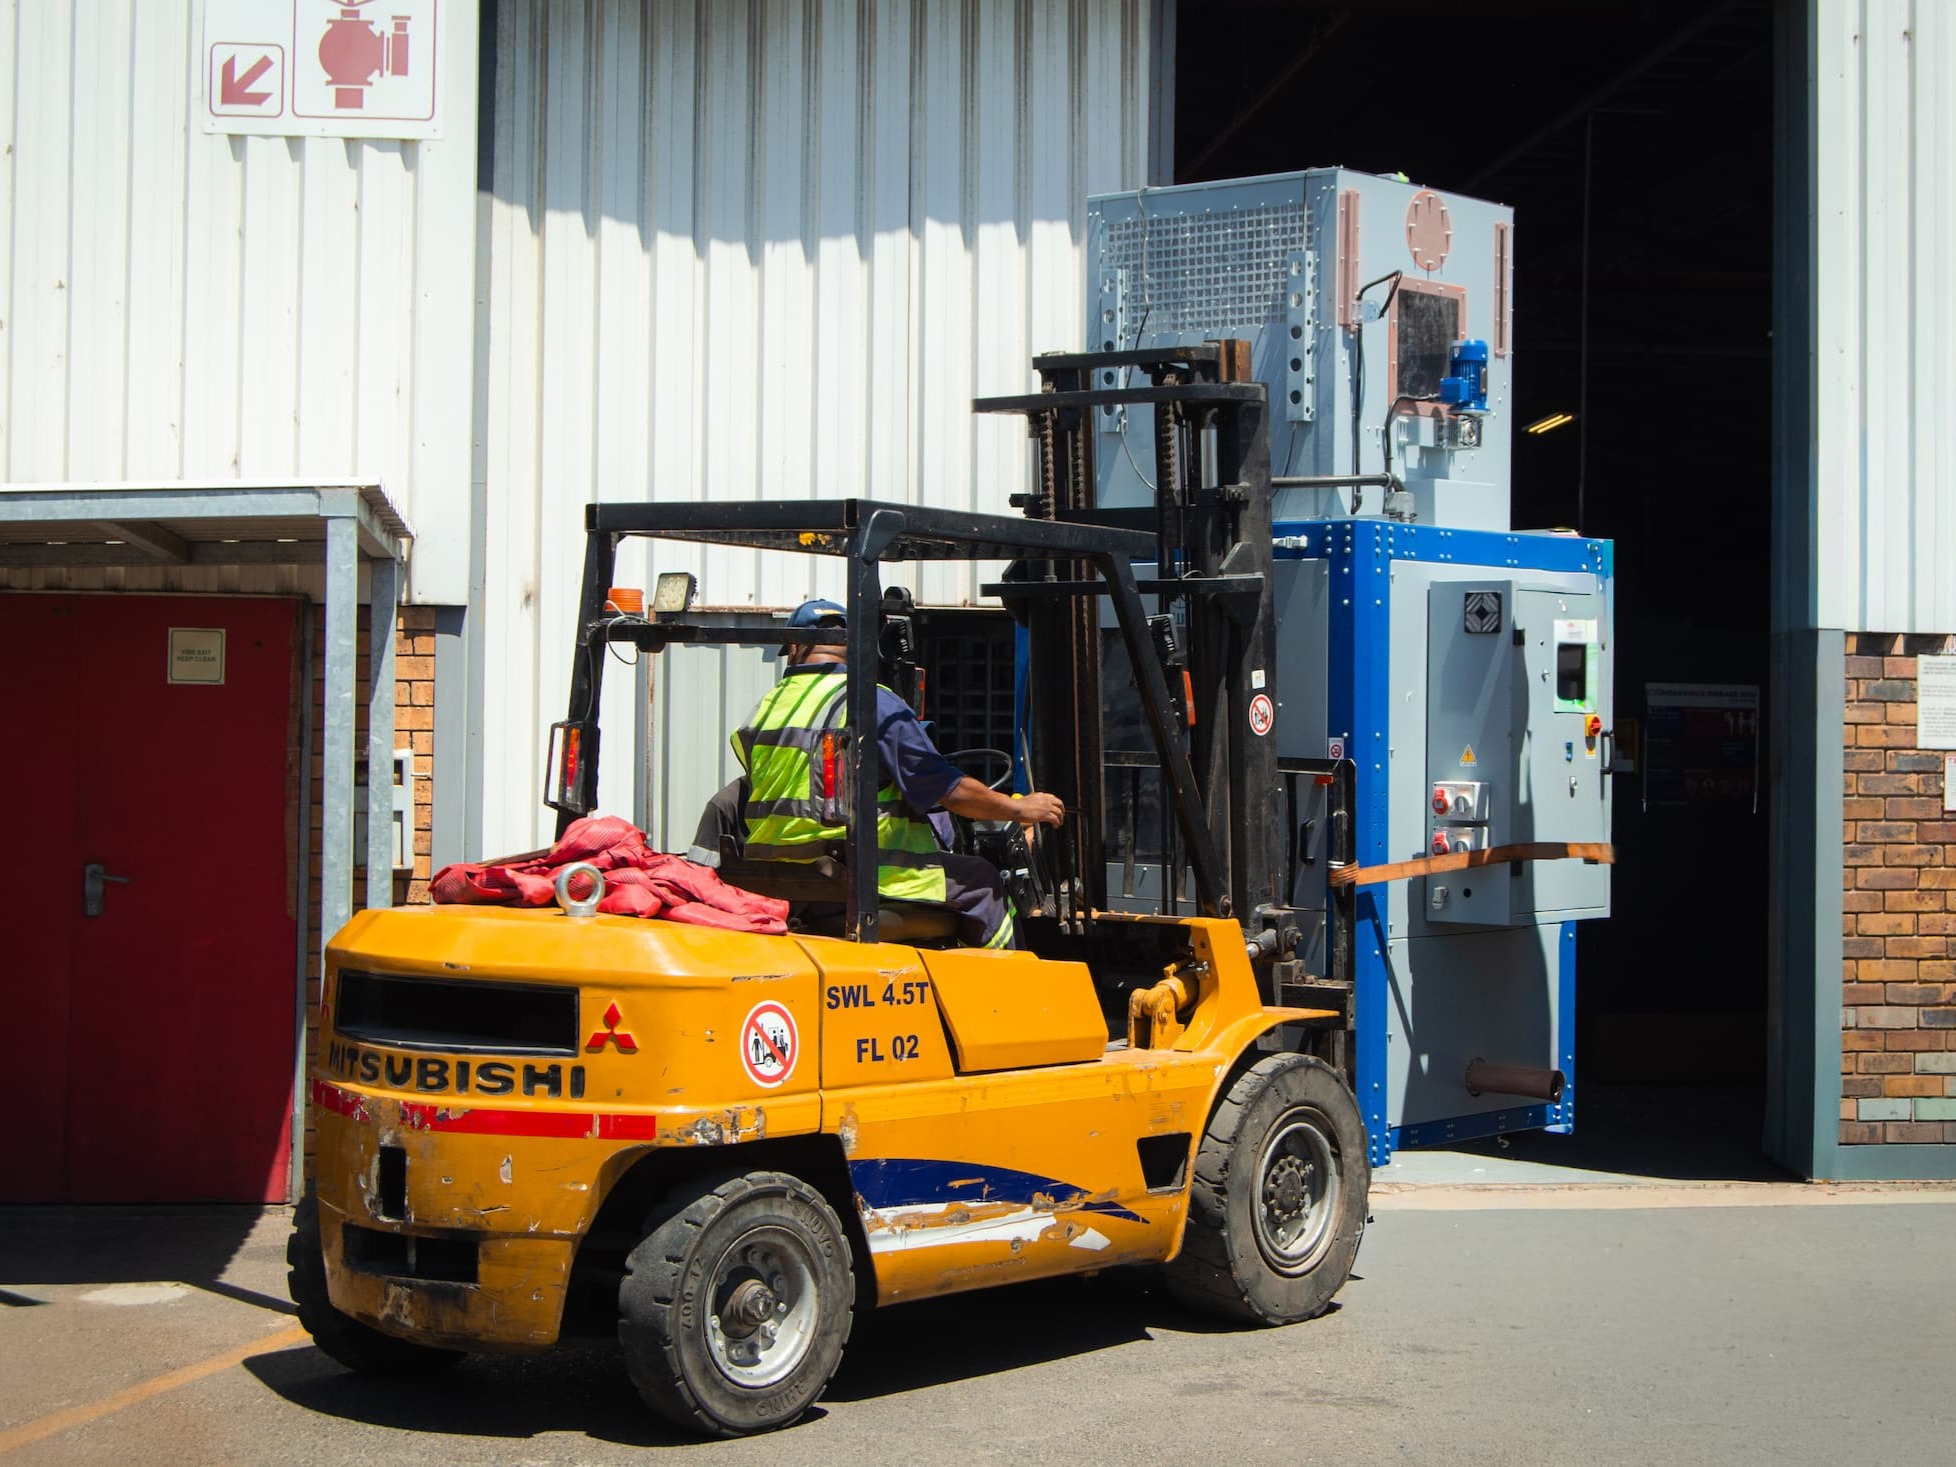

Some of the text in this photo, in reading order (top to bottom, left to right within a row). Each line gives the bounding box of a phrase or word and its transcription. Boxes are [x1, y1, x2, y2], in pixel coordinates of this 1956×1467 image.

[826, 982, 929, 1010] SWL 4.5T
[856, 1034, 919, 1063] FL 02
[328, 1040, 586, 1099] MITSUBISHI
